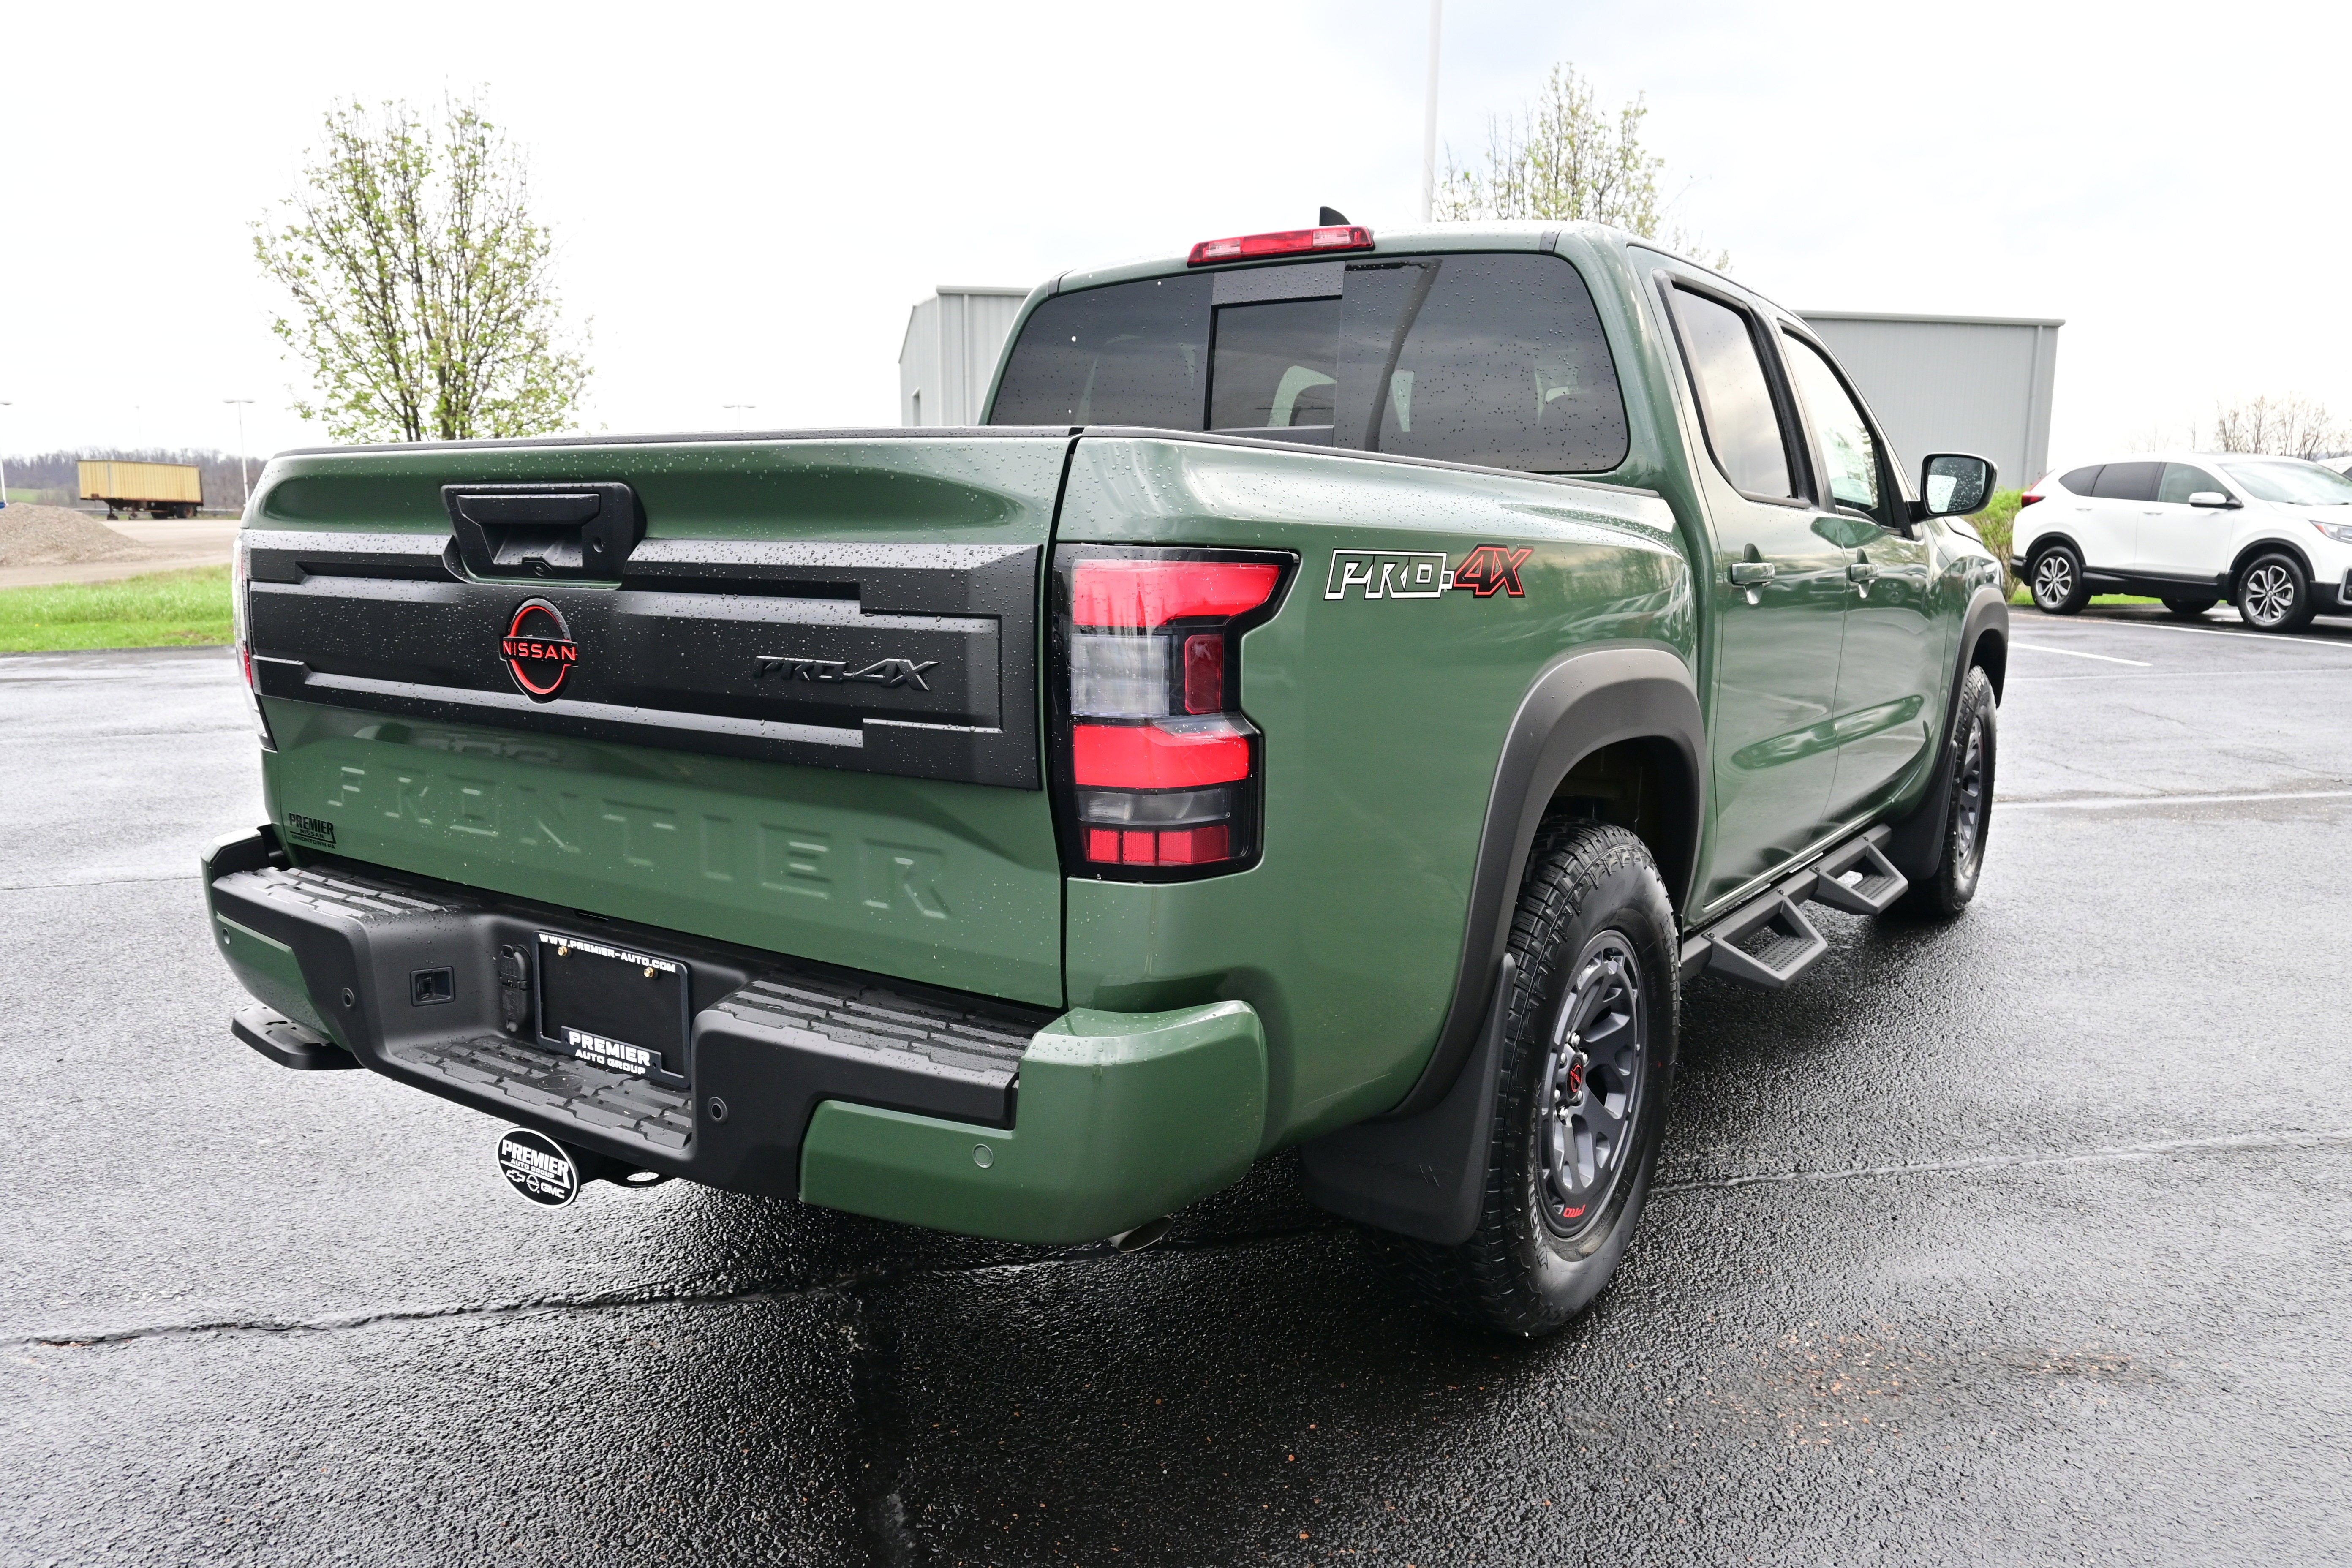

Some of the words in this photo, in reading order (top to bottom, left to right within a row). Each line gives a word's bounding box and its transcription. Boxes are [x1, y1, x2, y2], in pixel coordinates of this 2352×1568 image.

[503, 640, 576, 661] NISSAN
[289, 813, 334, 835] PREMIER
[300, 829, 324, 838] NISSAN
[292, 834, 326, 847] UNIONTOWN
[323, 754, 952, 920] FRONTIER
[539, 934, 675, 972] WWW.PREMIER-AUTO.COM
[569, 1031, 650, 1066] PREMIER
[575, 1049, 605, 1064] AUTO
[607, 1058, 645, 1075] GROUP
[502, 1139, 569, 1176] PREMIER
[511, 1159, 529, 1171] AUTO
[531, 1165, 555, 1179] GROUP
[541, 1182, 565, 1199] GMC
